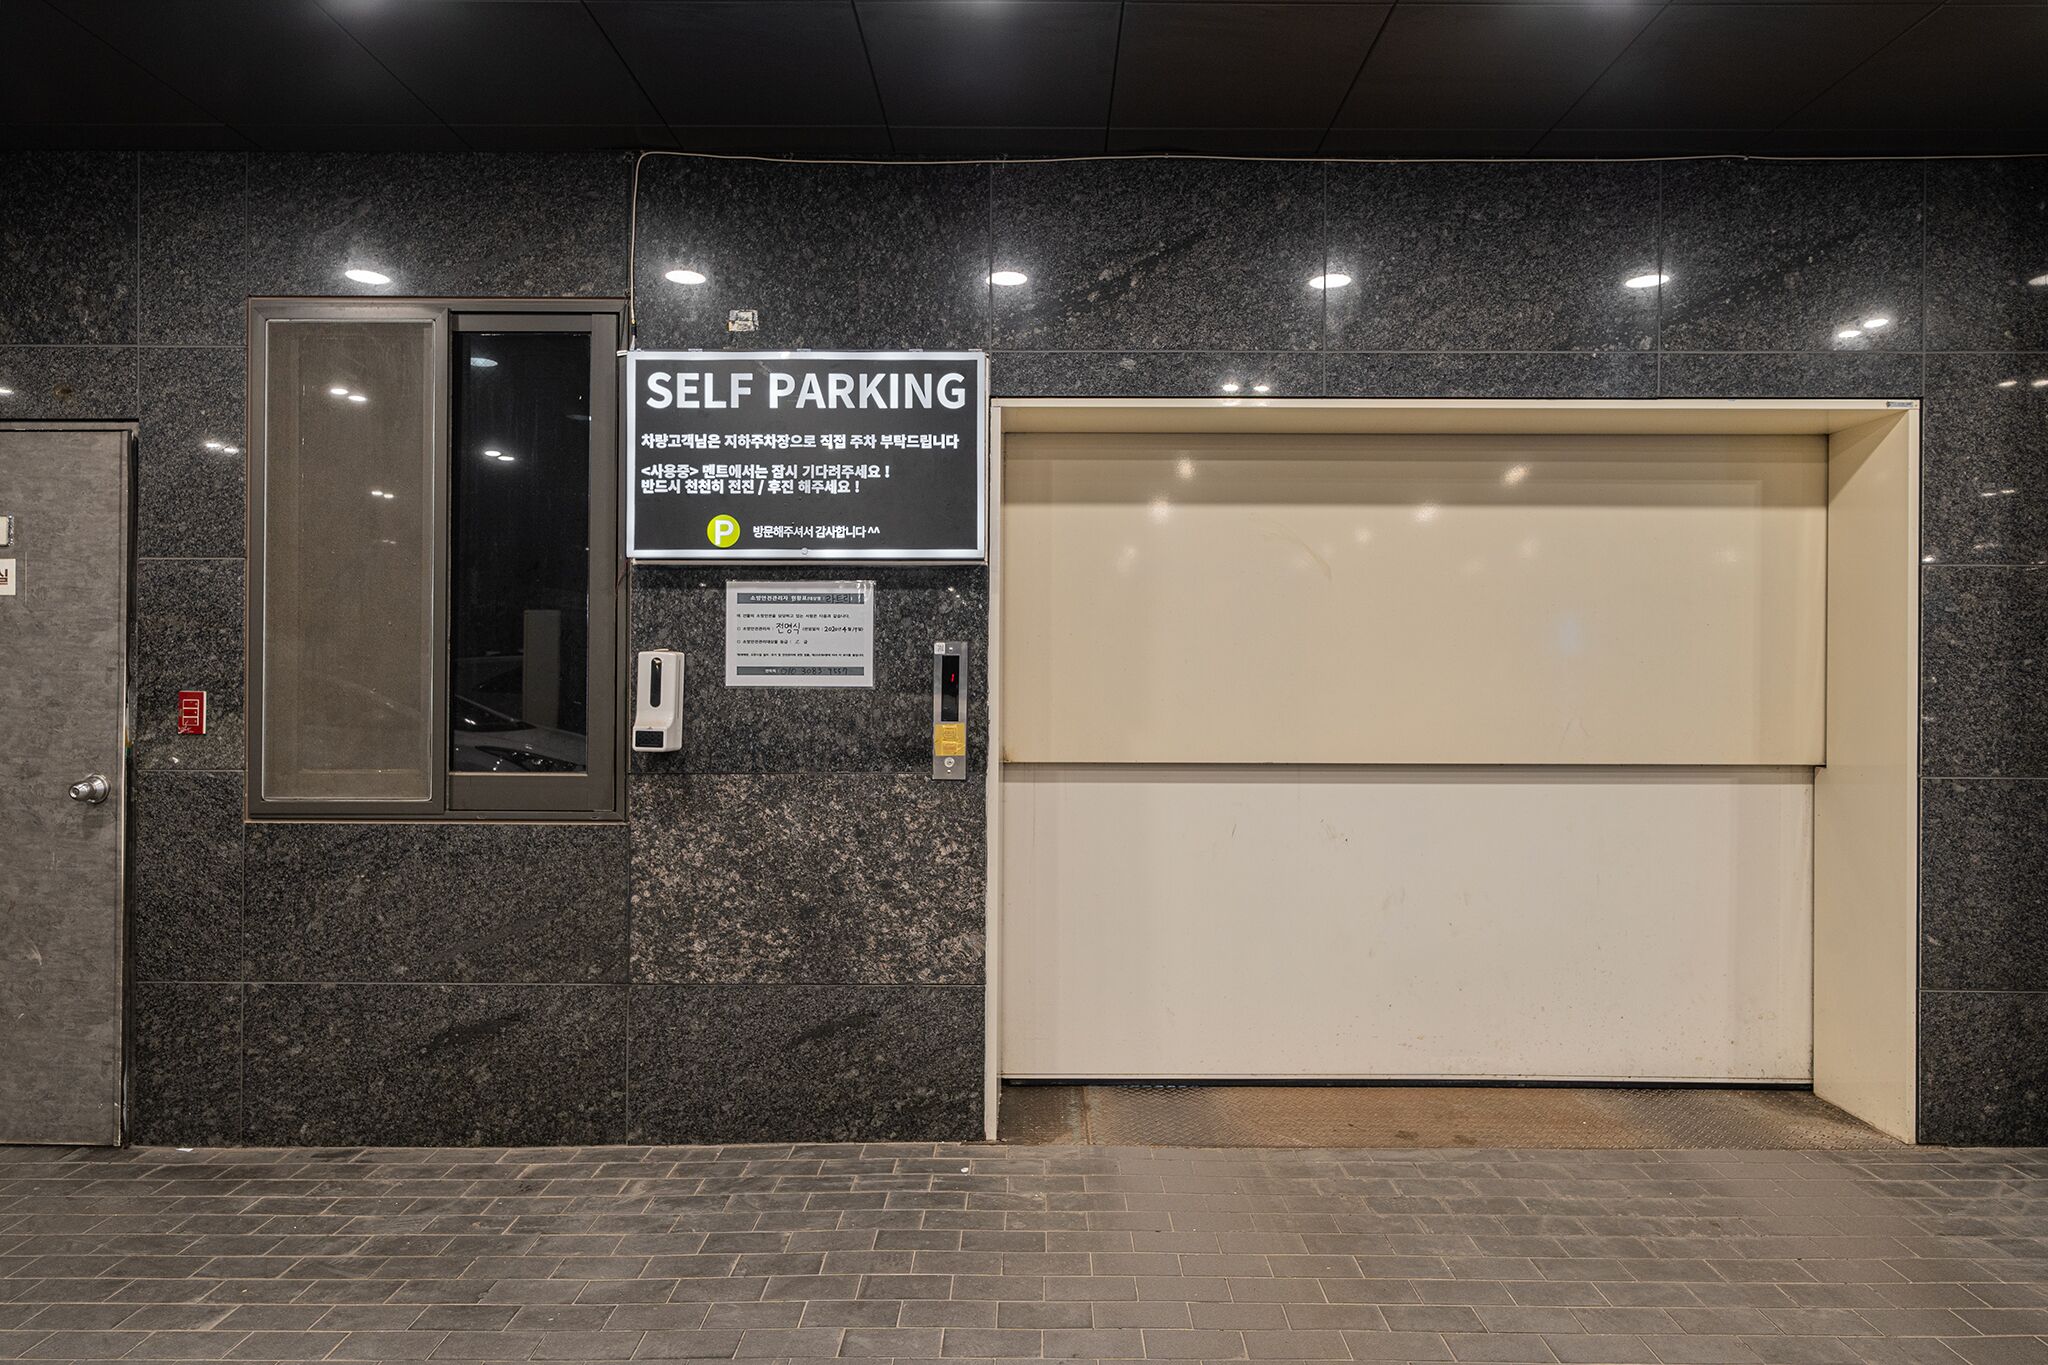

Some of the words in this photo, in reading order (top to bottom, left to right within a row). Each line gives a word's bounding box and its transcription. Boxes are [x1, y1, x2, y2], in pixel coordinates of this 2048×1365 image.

[646, 371, 753, 409] SELF
[769, 371, 966, 409] PARKING
[641, 433, 721, 449] 차량고객님은
[724, 433, 816, 449] 지하주차장으로
[820, 433, 846, 450] 직접
[850, 434, 876, 449] 주차
[880, 433, 959, 449] 부탁드립니다
[702, 463, 768, 479] 멘트에서는
[771, 464, 797, 479] 잠시
[802, 464, 881, 479] 기다려주세요
[641, 479, 680, 494] 반드시
[685, 479, 724, 494] 천천히
[728, 479, 754, 494] 전진
[767, 479, 794, 494] 후진
[798, 479, 851, 494] 해주세요
[714, 519, 734, 546] P
[753, 525, 813, 538] 방문해주셔서
[815, 525, 866, 538] 감사합니다
